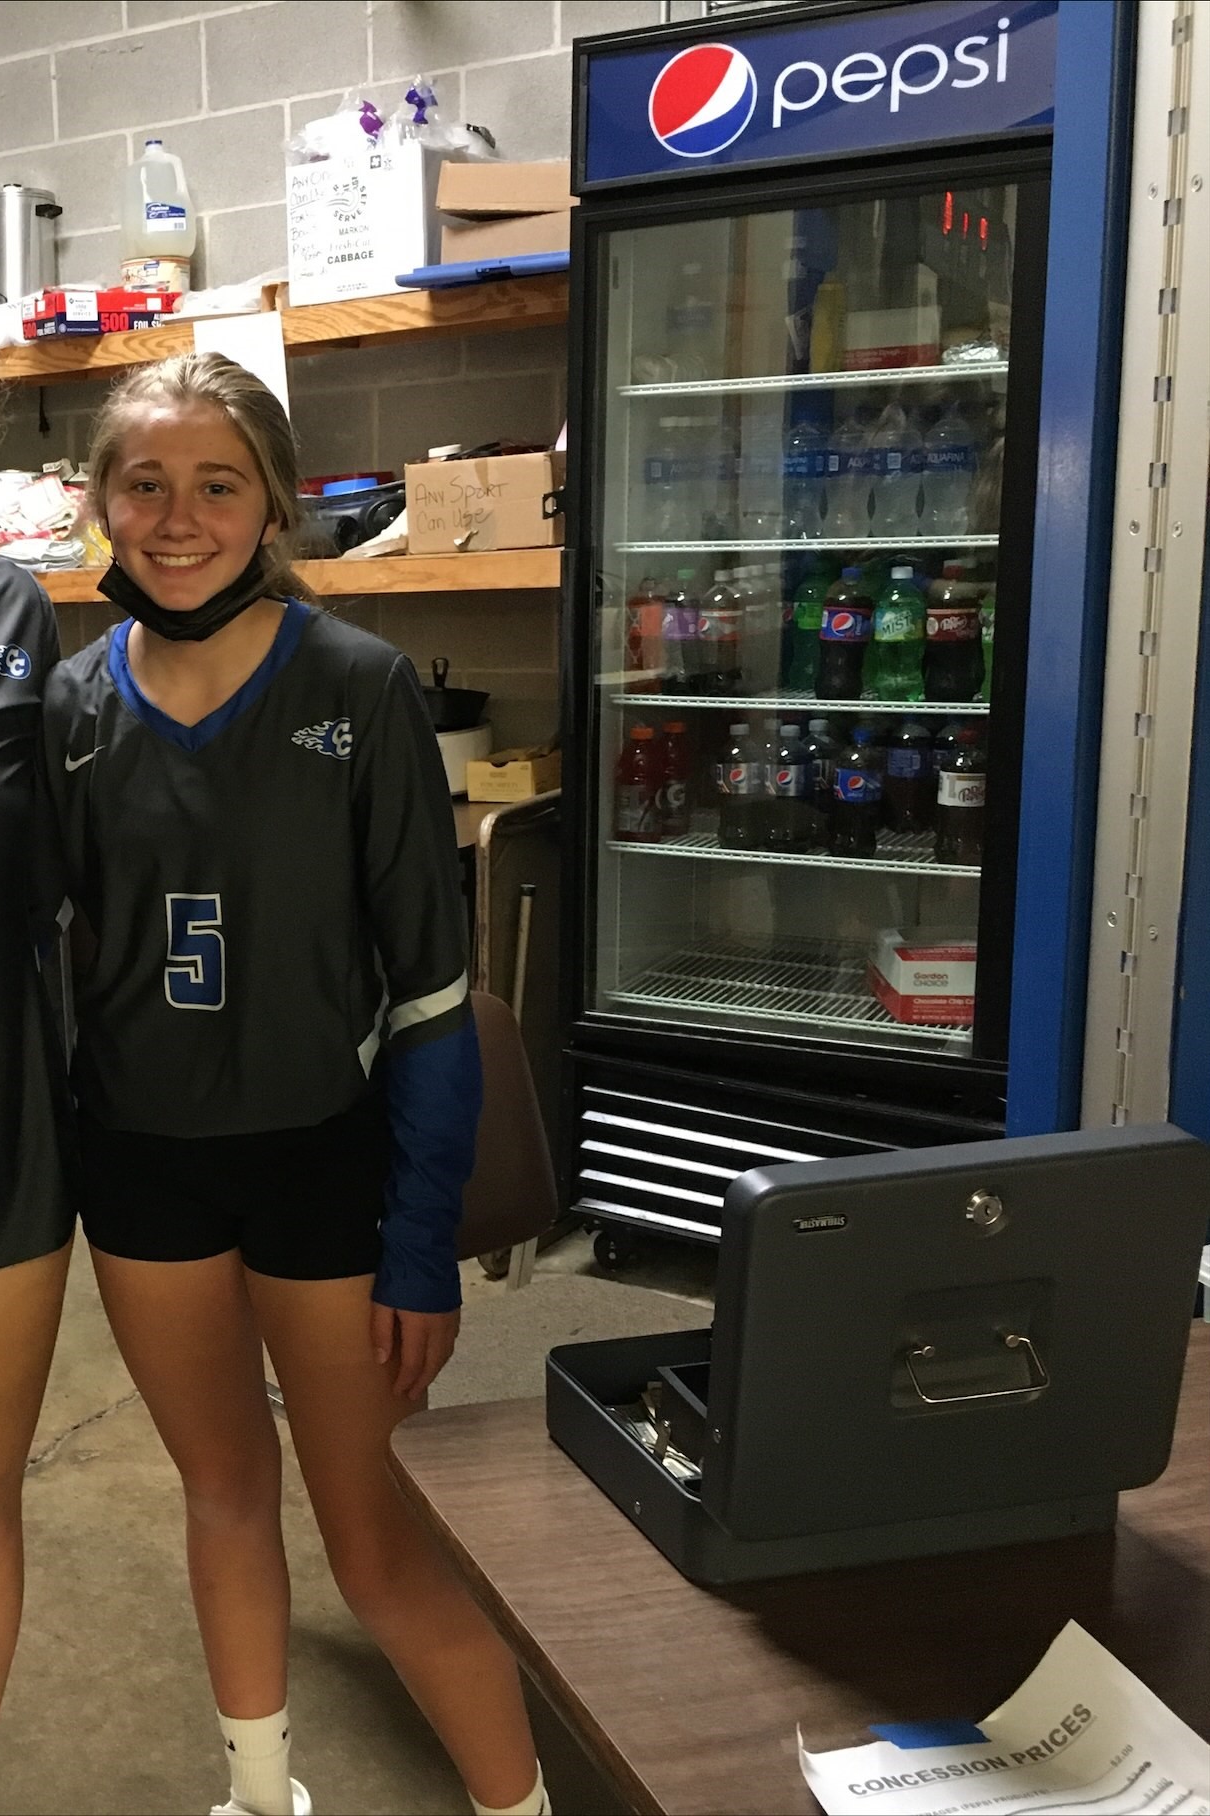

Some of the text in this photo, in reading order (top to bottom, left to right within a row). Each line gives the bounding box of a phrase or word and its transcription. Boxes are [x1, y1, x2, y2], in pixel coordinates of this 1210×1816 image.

[772, 17, 1009, 129] pepsi
[327, 250, 375, 265] CABBAGE
[101, 313, 129, 332] 500
[881, 617, 912, 635] MIST
[164, 892, 226, 1011] 5
[913, 972, 948, 980] Gordon
[847, 1702, 1094, 1798] CONCESSION PRICES
